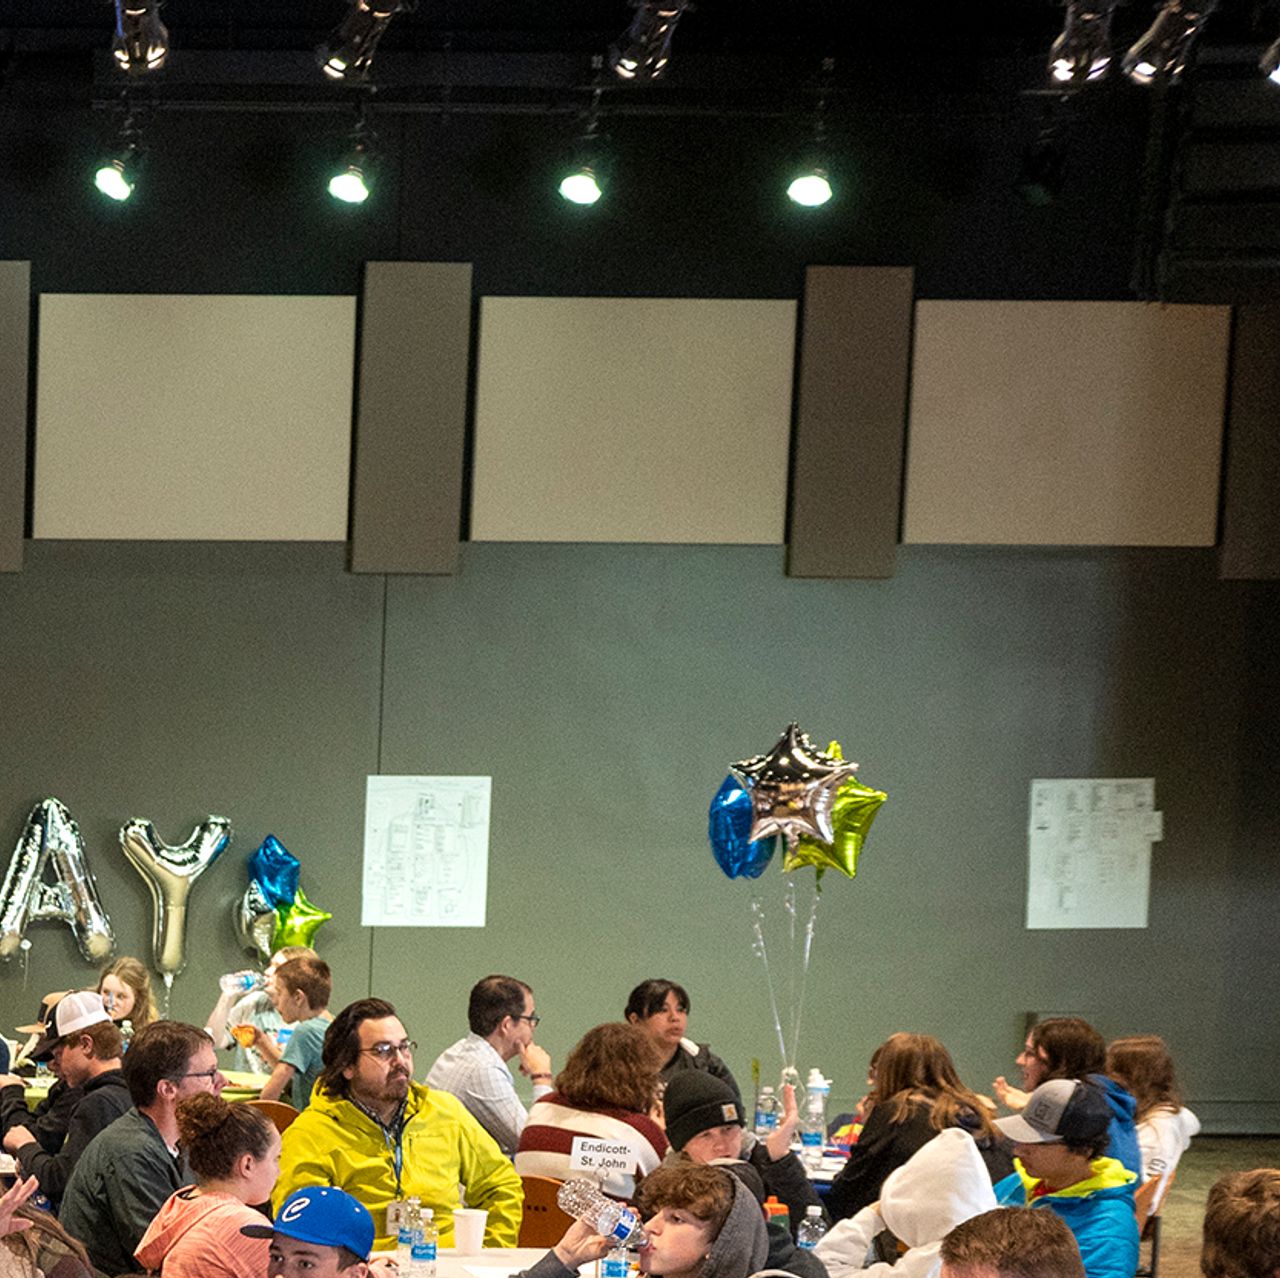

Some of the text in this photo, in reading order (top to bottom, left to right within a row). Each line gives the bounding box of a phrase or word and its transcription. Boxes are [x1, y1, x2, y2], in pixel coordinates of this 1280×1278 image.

[581, 1141, 631, 1155] Endicott-
[581, 1155, 627, 1169] St. John
